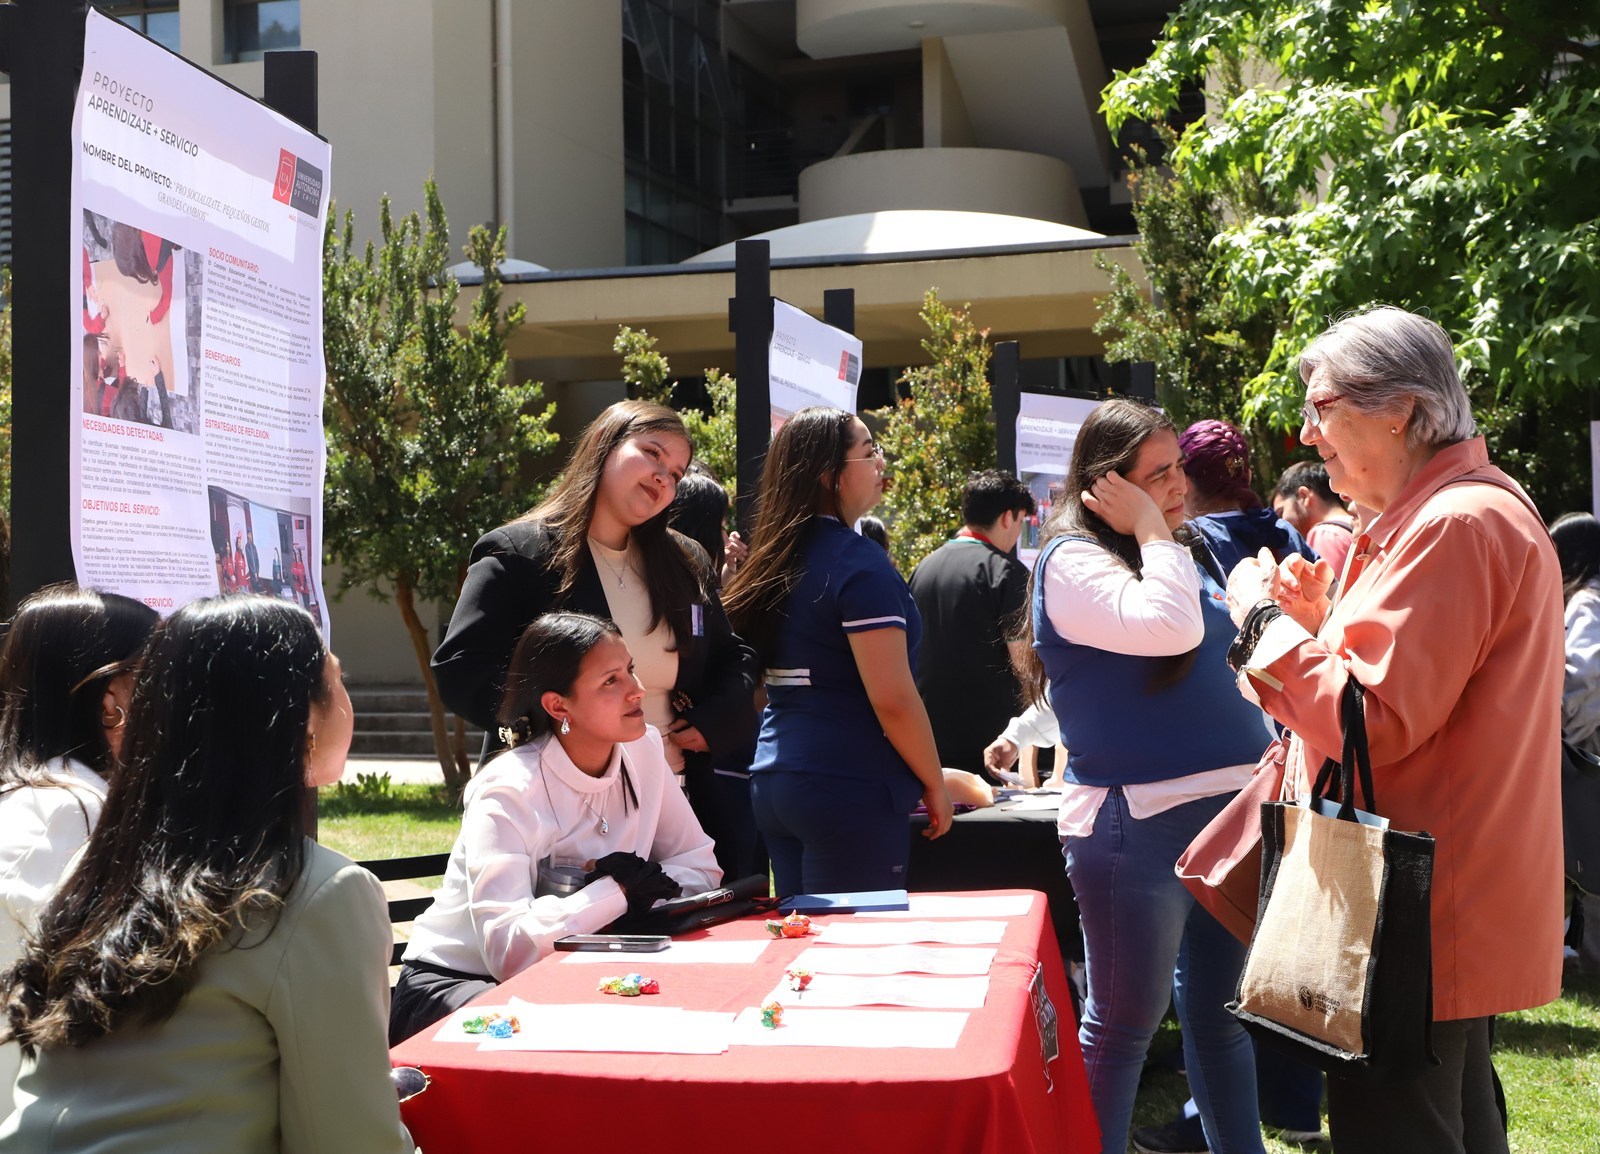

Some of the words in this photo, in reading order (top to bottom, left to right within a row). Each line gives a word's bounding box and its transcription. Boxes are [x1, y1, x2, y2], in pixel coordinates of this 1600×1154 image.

[93, 72, 153, 112] PROYECTO
[88, 95, 152, 135] APRENDIZAJE
[154, 128, 158, 136] +
[160, 129, 198, 157] SERVICIO
[83, 142, 116, 165] NOMBRE
[118, 157, 132, 172] DEL
[135, 164, 172, 189] PROYECTO:
[297, 172, 321, 188] UNIVERSIDAD
[158, 192, 182, 211] GRANDES
[303, 194, 318, 206] CHILE
[209, 248, 224, 260] SOCIO
[225, 254, 259, 273] COMUNITARIO:
[83, 419, 125, 435] NECESIDADES
[126, 426, 164, 442] DETECTADAS:
[206, 419, 237, 433] ESTRATEGIAS
[238, 426, 244, 434] DE
[82, 499, 118, 512] OBJETIVOS
[120, 503, 131, 513] DEL
[133, 504, 160, 516] SERVICIO:
[144, 598, 174, 607] SERVICIO:
